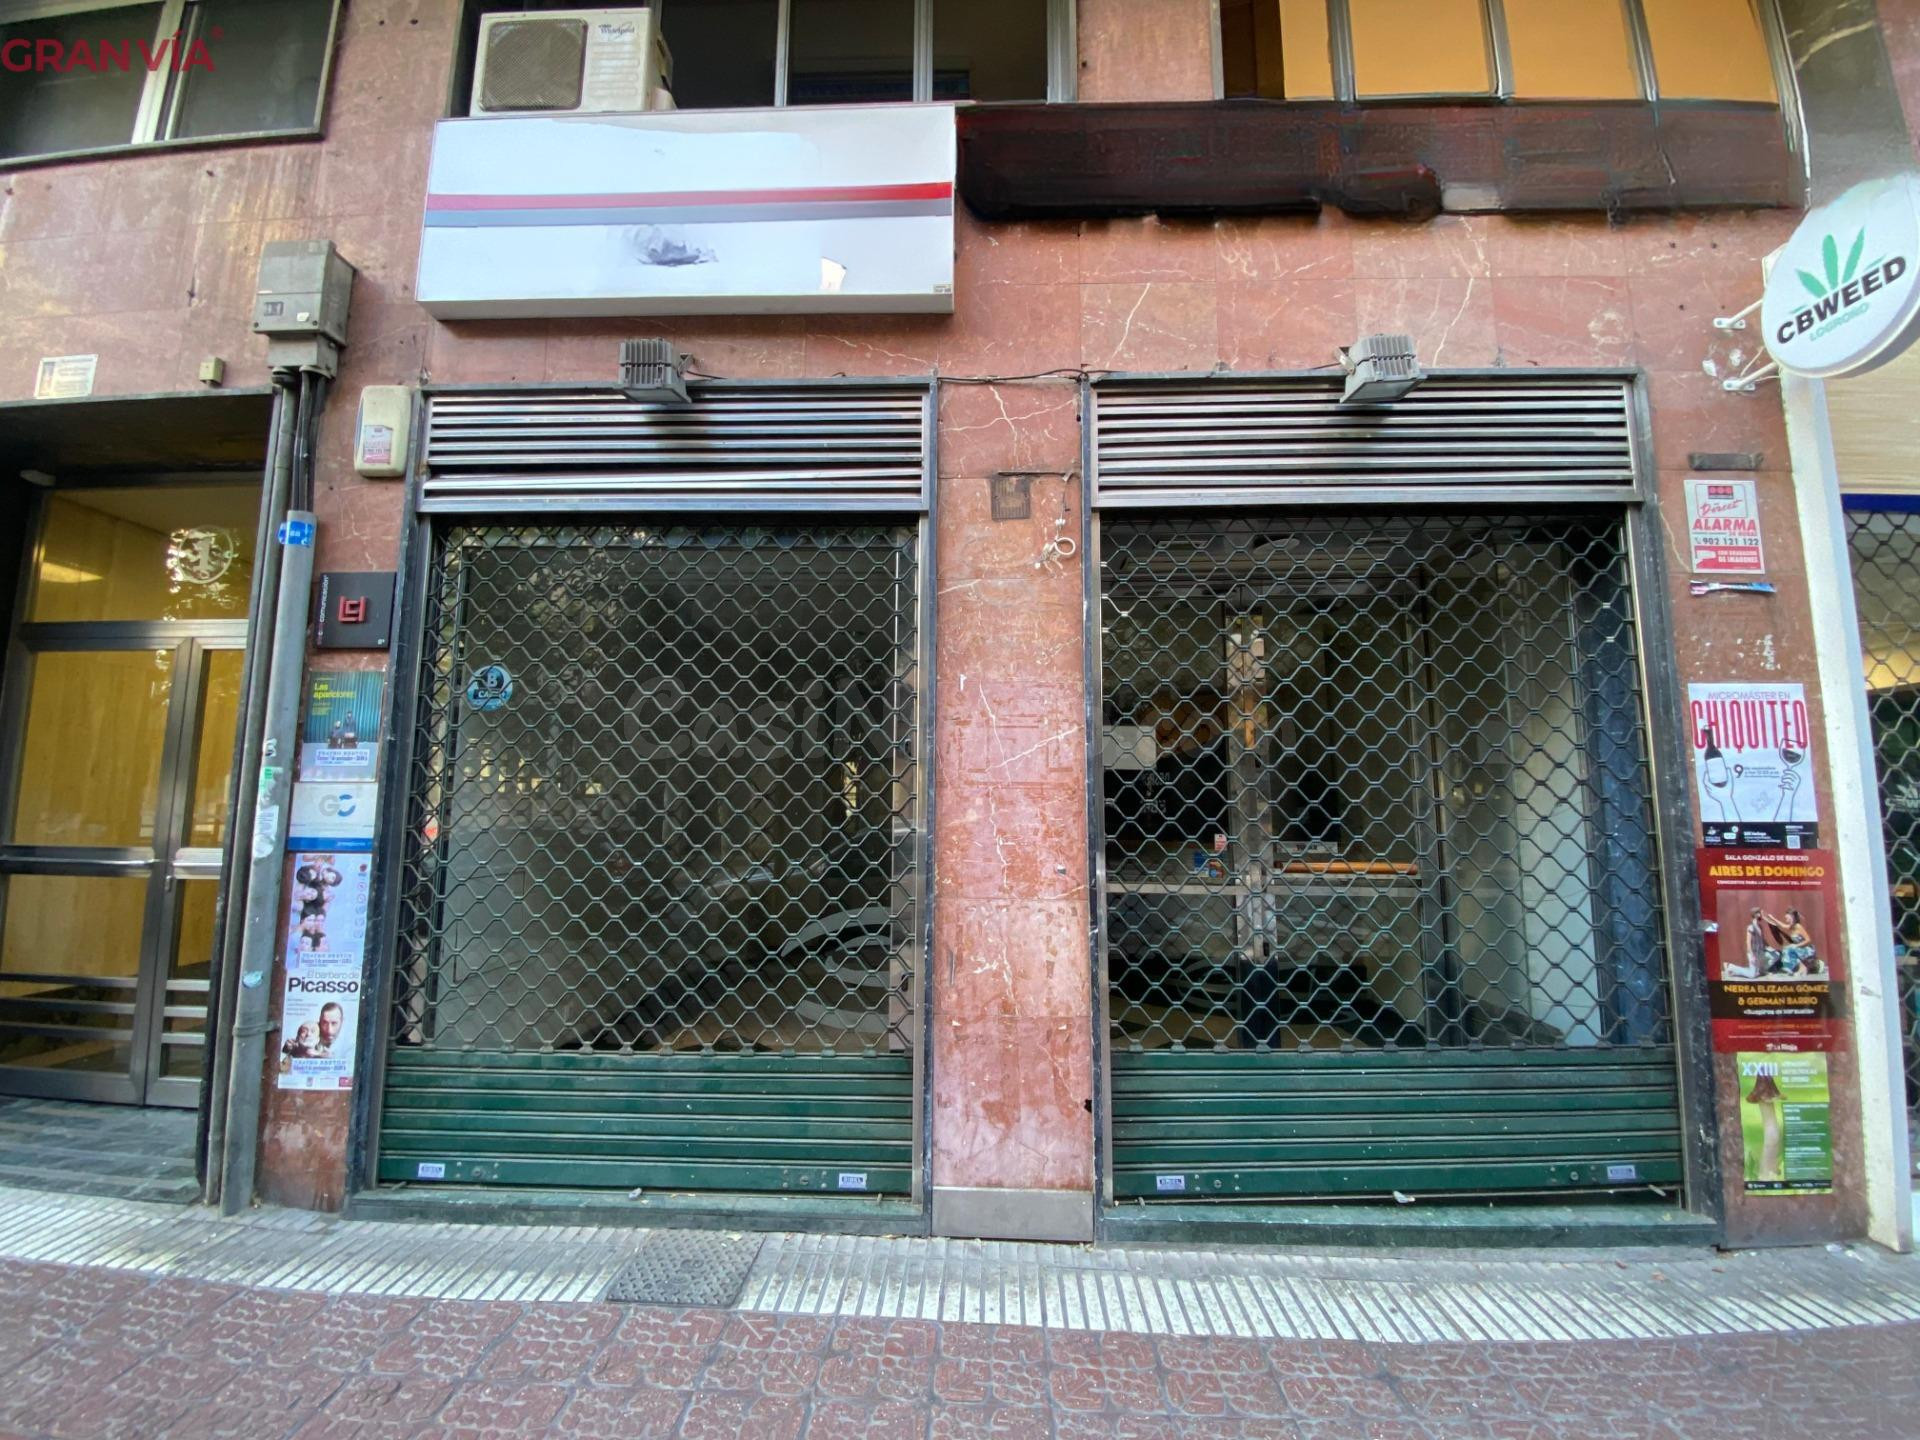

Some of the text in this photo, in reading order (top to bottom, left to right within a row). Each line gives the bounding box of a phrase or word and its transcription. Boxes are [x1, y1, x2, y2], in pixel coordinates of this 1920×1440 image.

[1777, 256, 1907, 344] CBWEED
[1692, 518, 1757, 531] ALARMA
[1703, 537, 1720, 545] 902
[1743, 538, 1759, 546] 122
[1779, 691, 1790, 700] EN
[1691, 700, 1809, 753] CHIQUITEO
[1734, 764, 1744, 778] 9
[1709, 865, 1825, 877] AIRES DE DOMINGO
[288, 977, 360, 993] Picasso
[1724, 985, 1756, 993] NEREA
[1796, 984, 1829, 993] GÓMEZ
